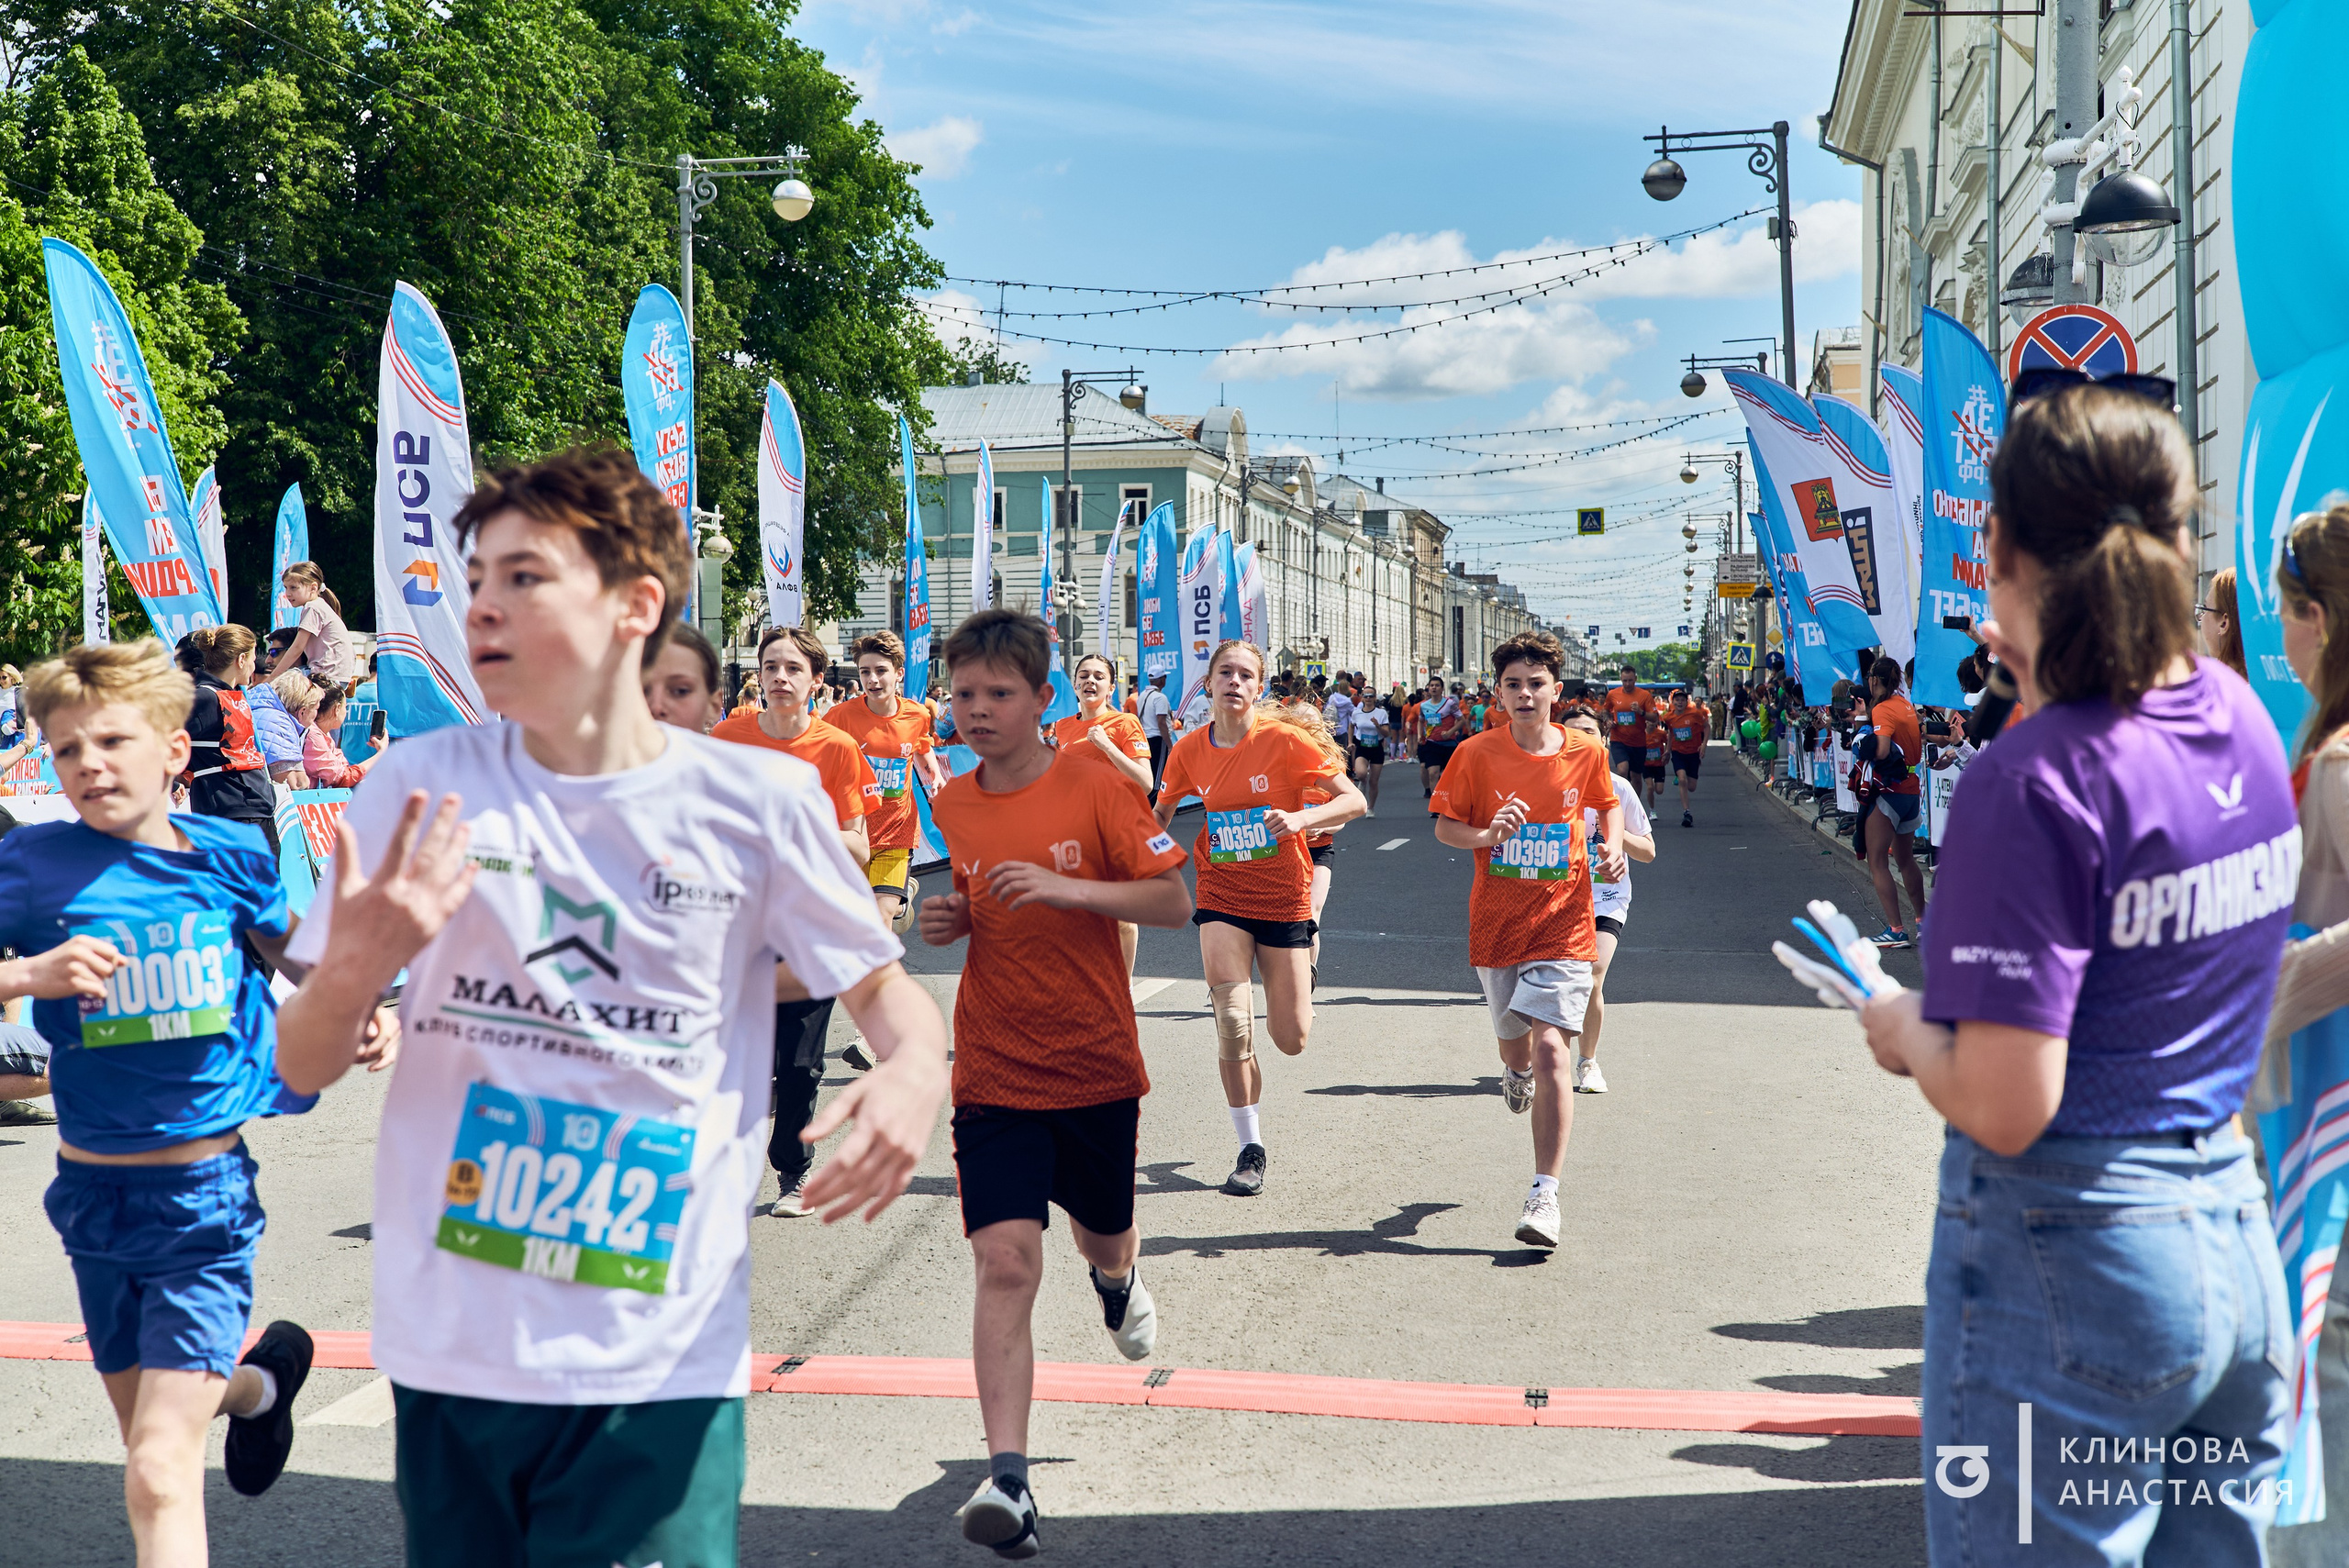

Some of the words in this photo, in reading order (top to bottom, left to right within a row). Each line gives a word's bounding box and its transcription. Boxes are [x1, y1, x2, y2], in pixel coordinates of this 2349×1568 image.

[1194, 584, 1211, 635] ПСБ
[874, 769, 900, 789] 095
[1217, 822, 1267, 851] 10350
[1235, 850, 1252, 862] 1KM
[1502, 838, 1560, 867] 10396
[1520, 867, 1539, 880] 1KM
[2110, 823, 2304, 950] ОРГАНИЗАТ
[452, 974, 689, 1035] МАЛАХИТ
[148, 1010, 192, 1041] 1KM
[475, 1140, 659, 1253] 10242
[520, 1236, 582, 1282] 1KM
